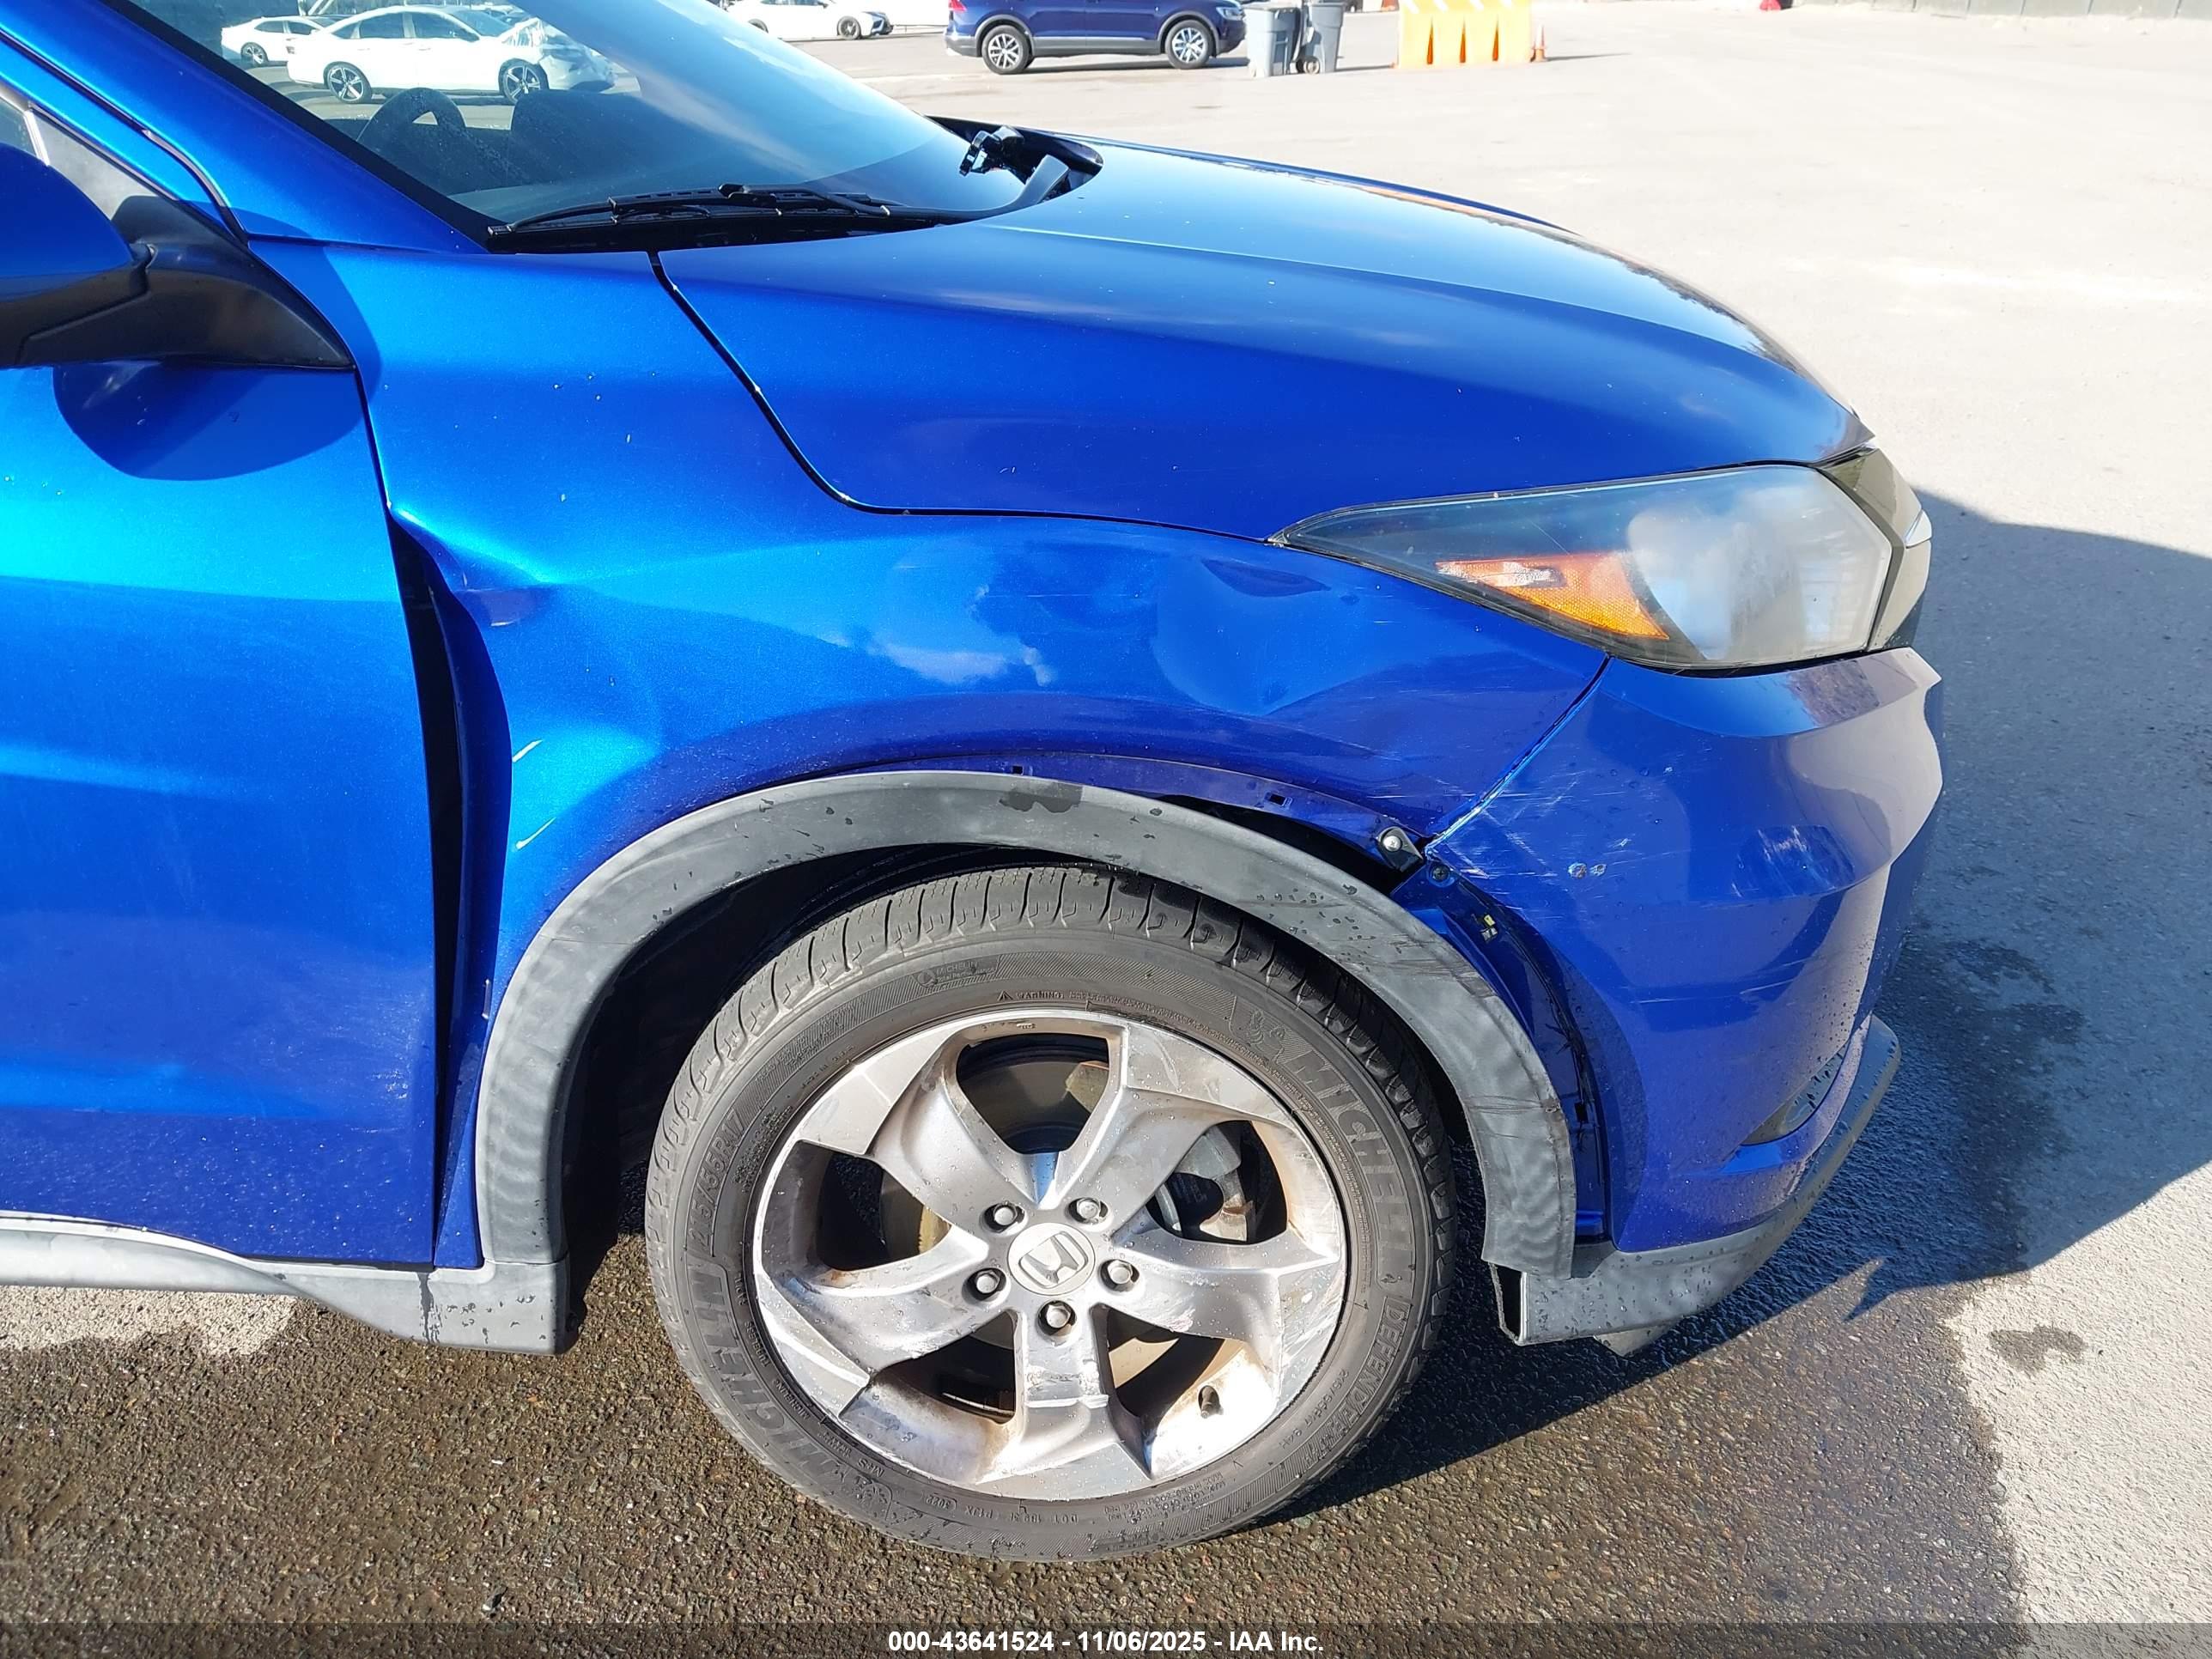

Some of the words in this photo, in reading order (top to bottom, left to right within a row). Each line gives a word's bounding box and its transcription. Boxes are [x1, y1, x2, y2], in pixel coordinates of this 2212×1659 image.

[686, 1109, 747, 1248] 215/55R17
[1282, 1043, 1413, 1284] MICHELIN
[690, 1269, 847, 1489] MICHELIN
[743, 1319, 772, 1368] TUBELESS
[1322, 1304, 1410, 1437] DEFENDER
